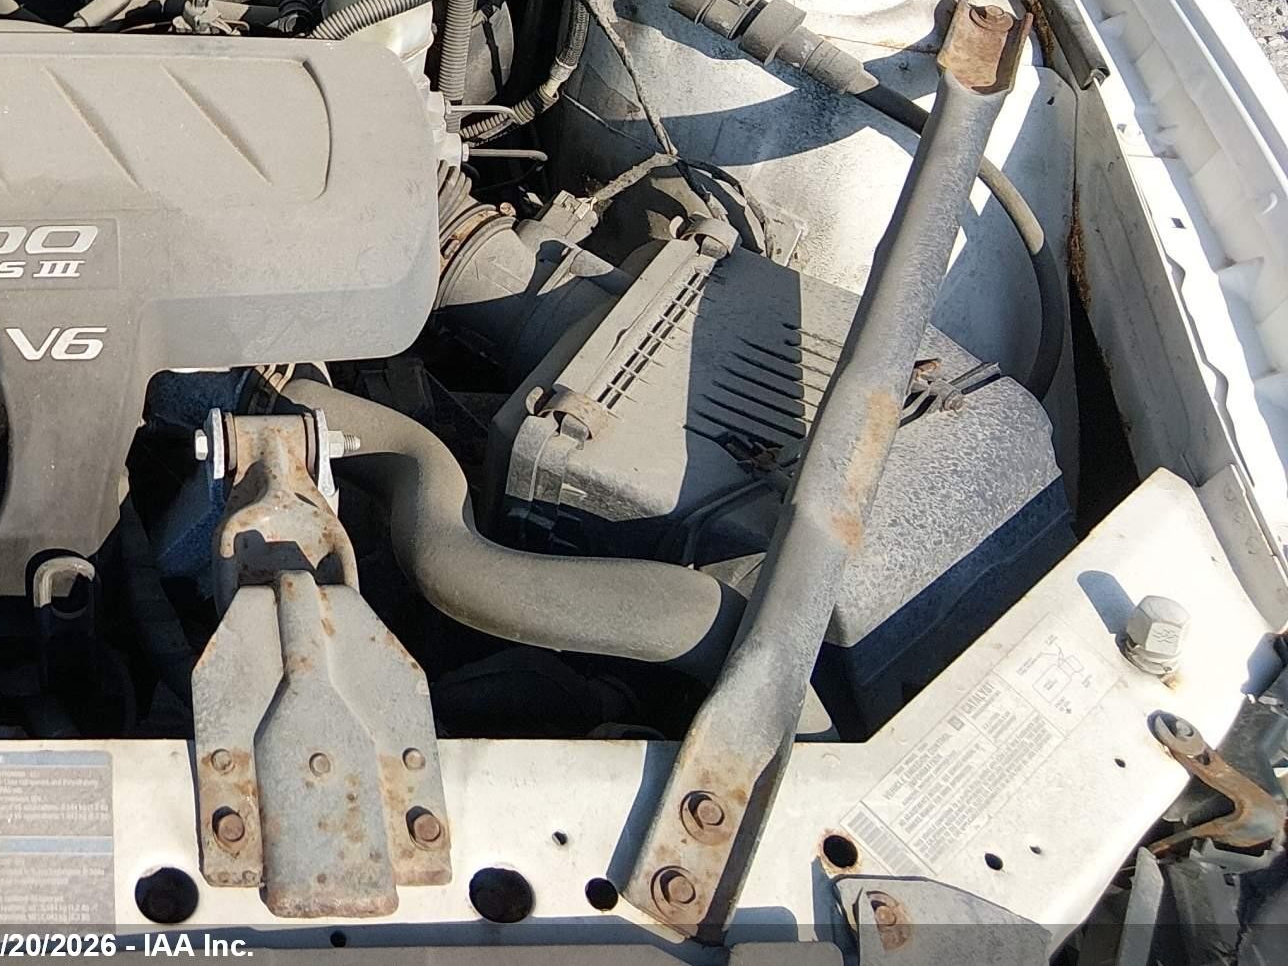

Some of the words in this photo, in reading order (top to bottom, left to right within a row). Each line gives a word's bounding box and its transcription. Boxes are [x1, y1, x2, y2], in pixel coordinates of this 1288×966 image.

[32, 260, 86, 278] III
[5, 327, 108, 361] V6
[960, 680, 995, 715] CATALYST
